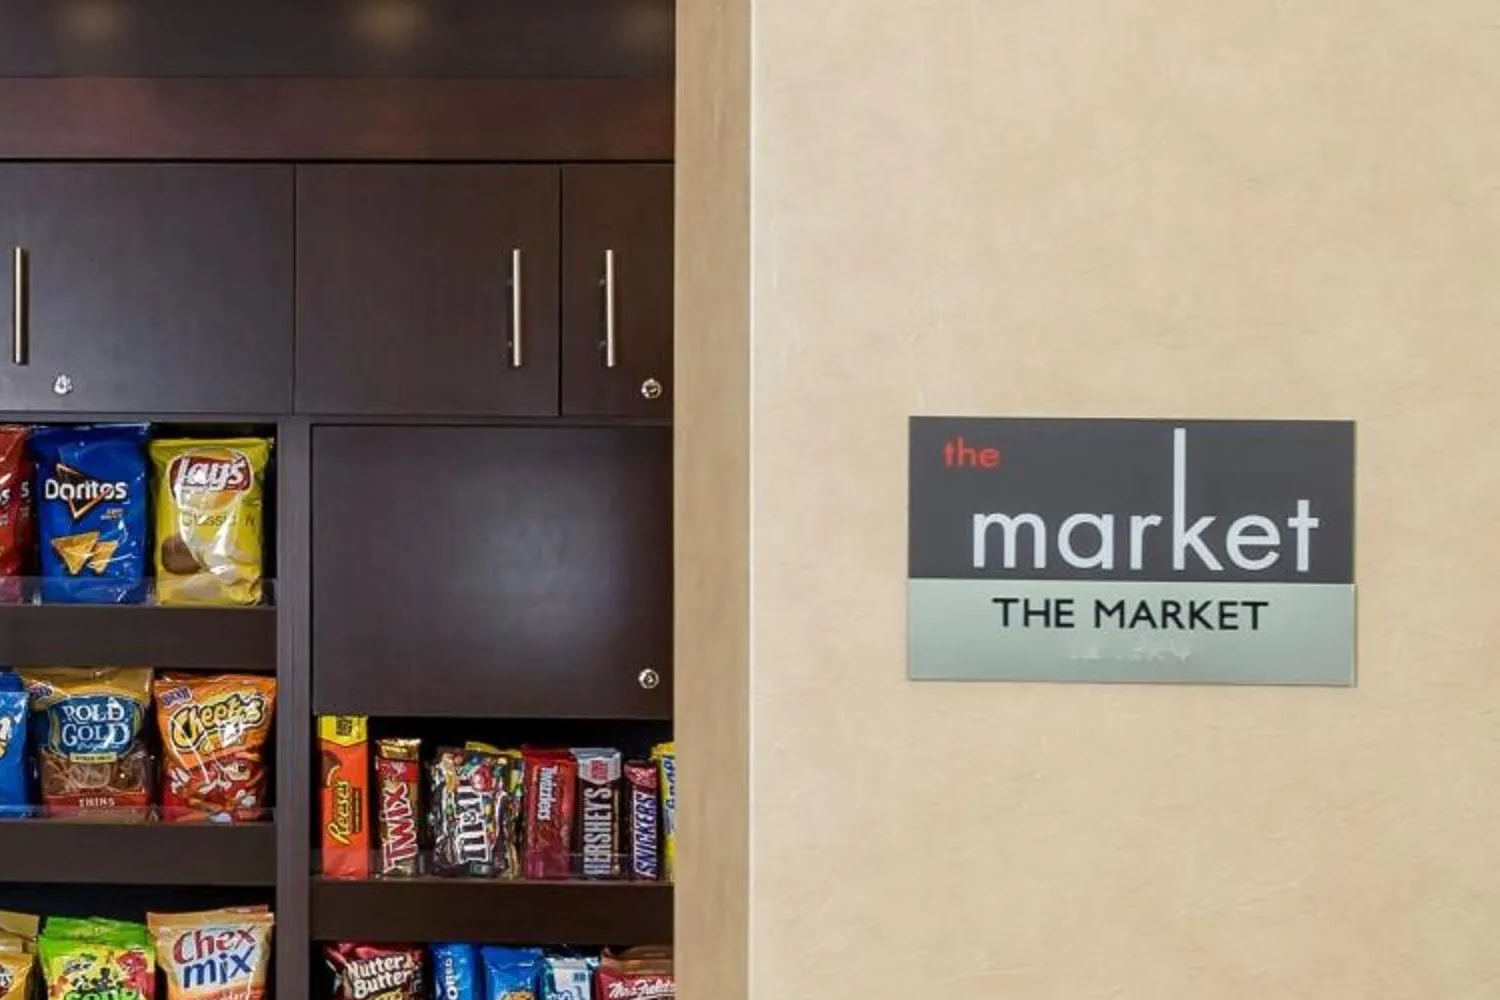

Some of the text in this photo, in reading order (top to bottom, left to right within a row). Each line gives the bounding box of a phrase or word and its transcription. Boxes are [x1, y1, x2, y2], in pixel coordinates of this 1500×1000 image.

[943, 437, 1000, 468] the
[45, 479, 129, 502] Doritos
[972, 428, 1320, 572] market
[992, 598, 1269, 630] THE MARKET
[61, 723, 131, 746] GOLD
[633, 789, 657, 879] SNICKERS
[173, 925, 261, 965] Chex
[347, 954, 406, 979] Nutter
[353, 968, 414, 999] Butter
